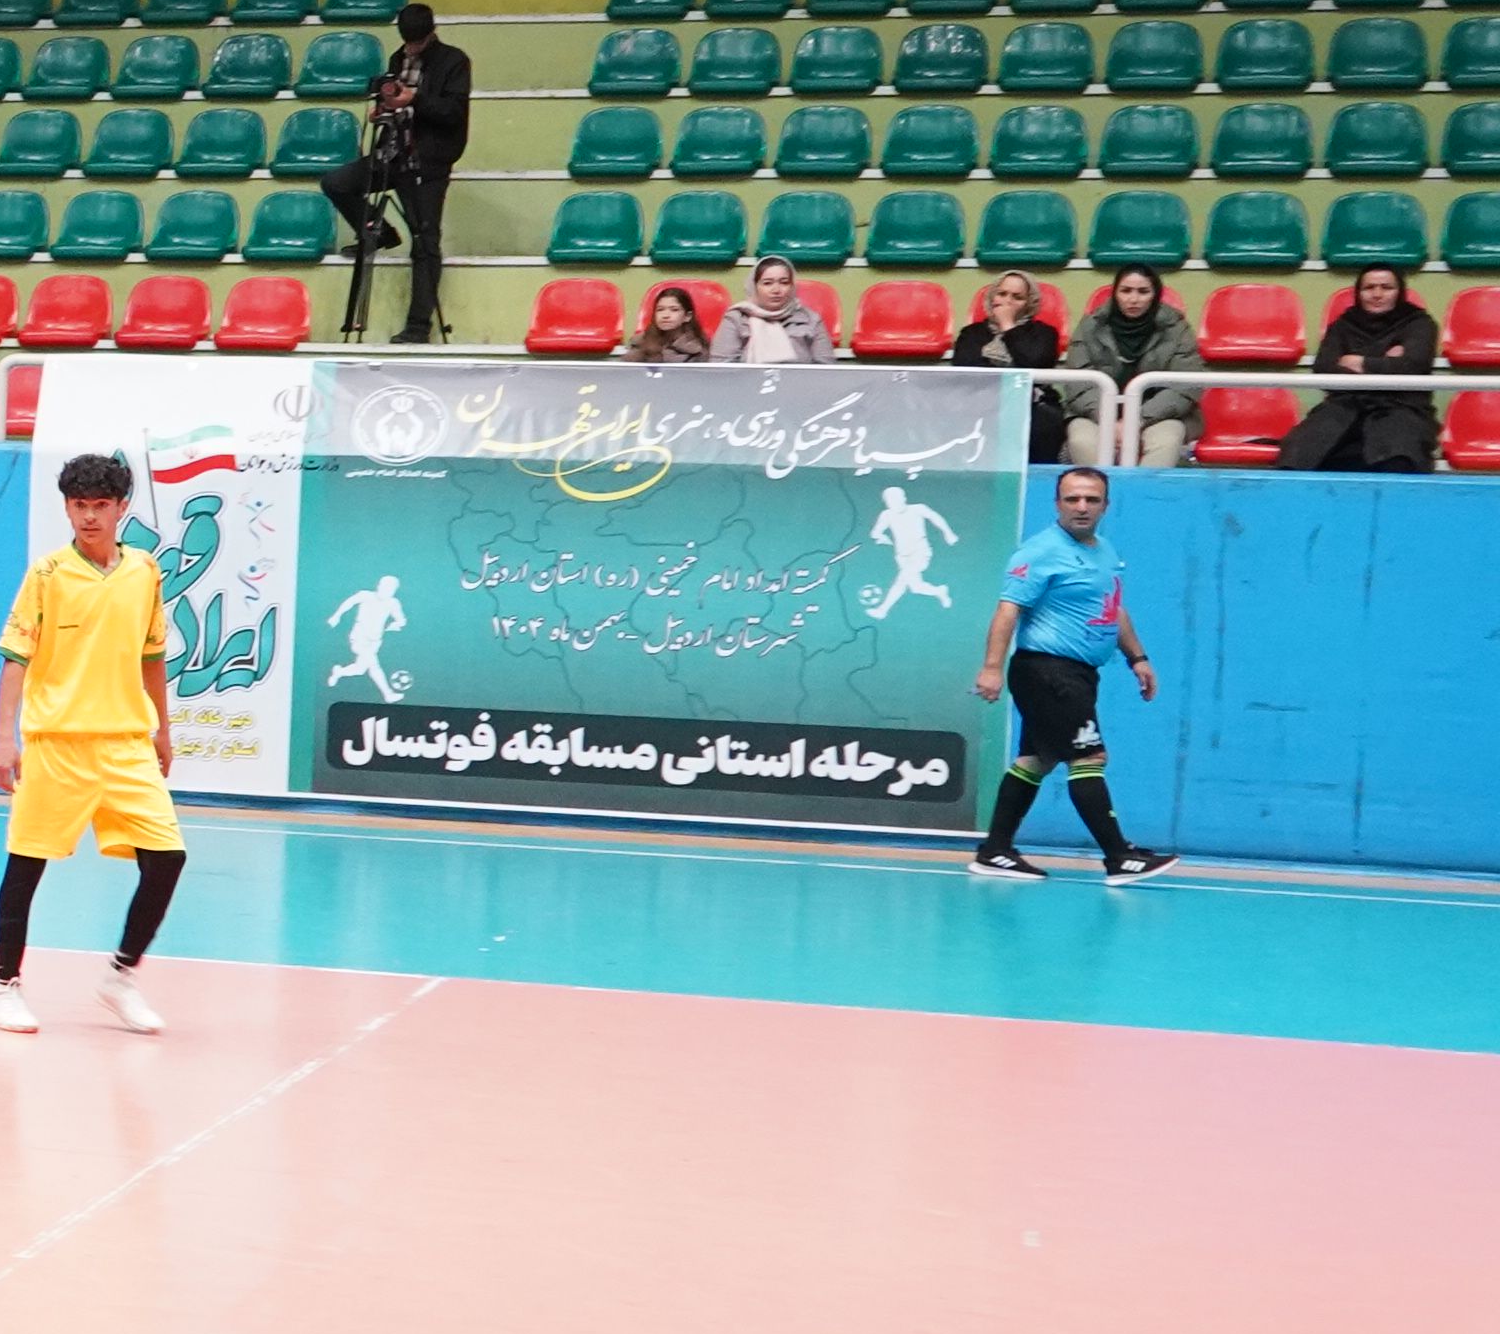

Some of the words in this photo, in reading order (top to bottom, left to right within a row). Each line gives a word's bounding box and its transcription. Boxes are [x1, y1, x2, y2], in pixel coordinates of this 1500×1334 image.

[457, 383, 600, 457] قهرمان
[728, 380, 786, 451] ورزشی
[765, 392, 865, 480] فرهنگی
[851, 417, 987, 481] المپیاد
[460, 549, 527, 591] اردبیل
[529, 552, 589, 593] استان
[645, 540, 699, 596] خمینی
[697, 566, 740, 610] امام
[744, 568, 788, 593] امداد
[790, 542, 861, 595] کمیته
[491, 614, 545, 641] ۱۴۰۴
[548, 615, 570, 642] ماه
[572, 609, 628, 651] بهمن
[642, 612, 712, 655] اردبیل
[714, 604, 820, 658] شهرستان
[341, 713, 497, 773] فوتسال
[500, 723, 656, 776] مسابقه
[661, 733, 806, 785] استانی
[808, 740, 951, 797] مرحله
